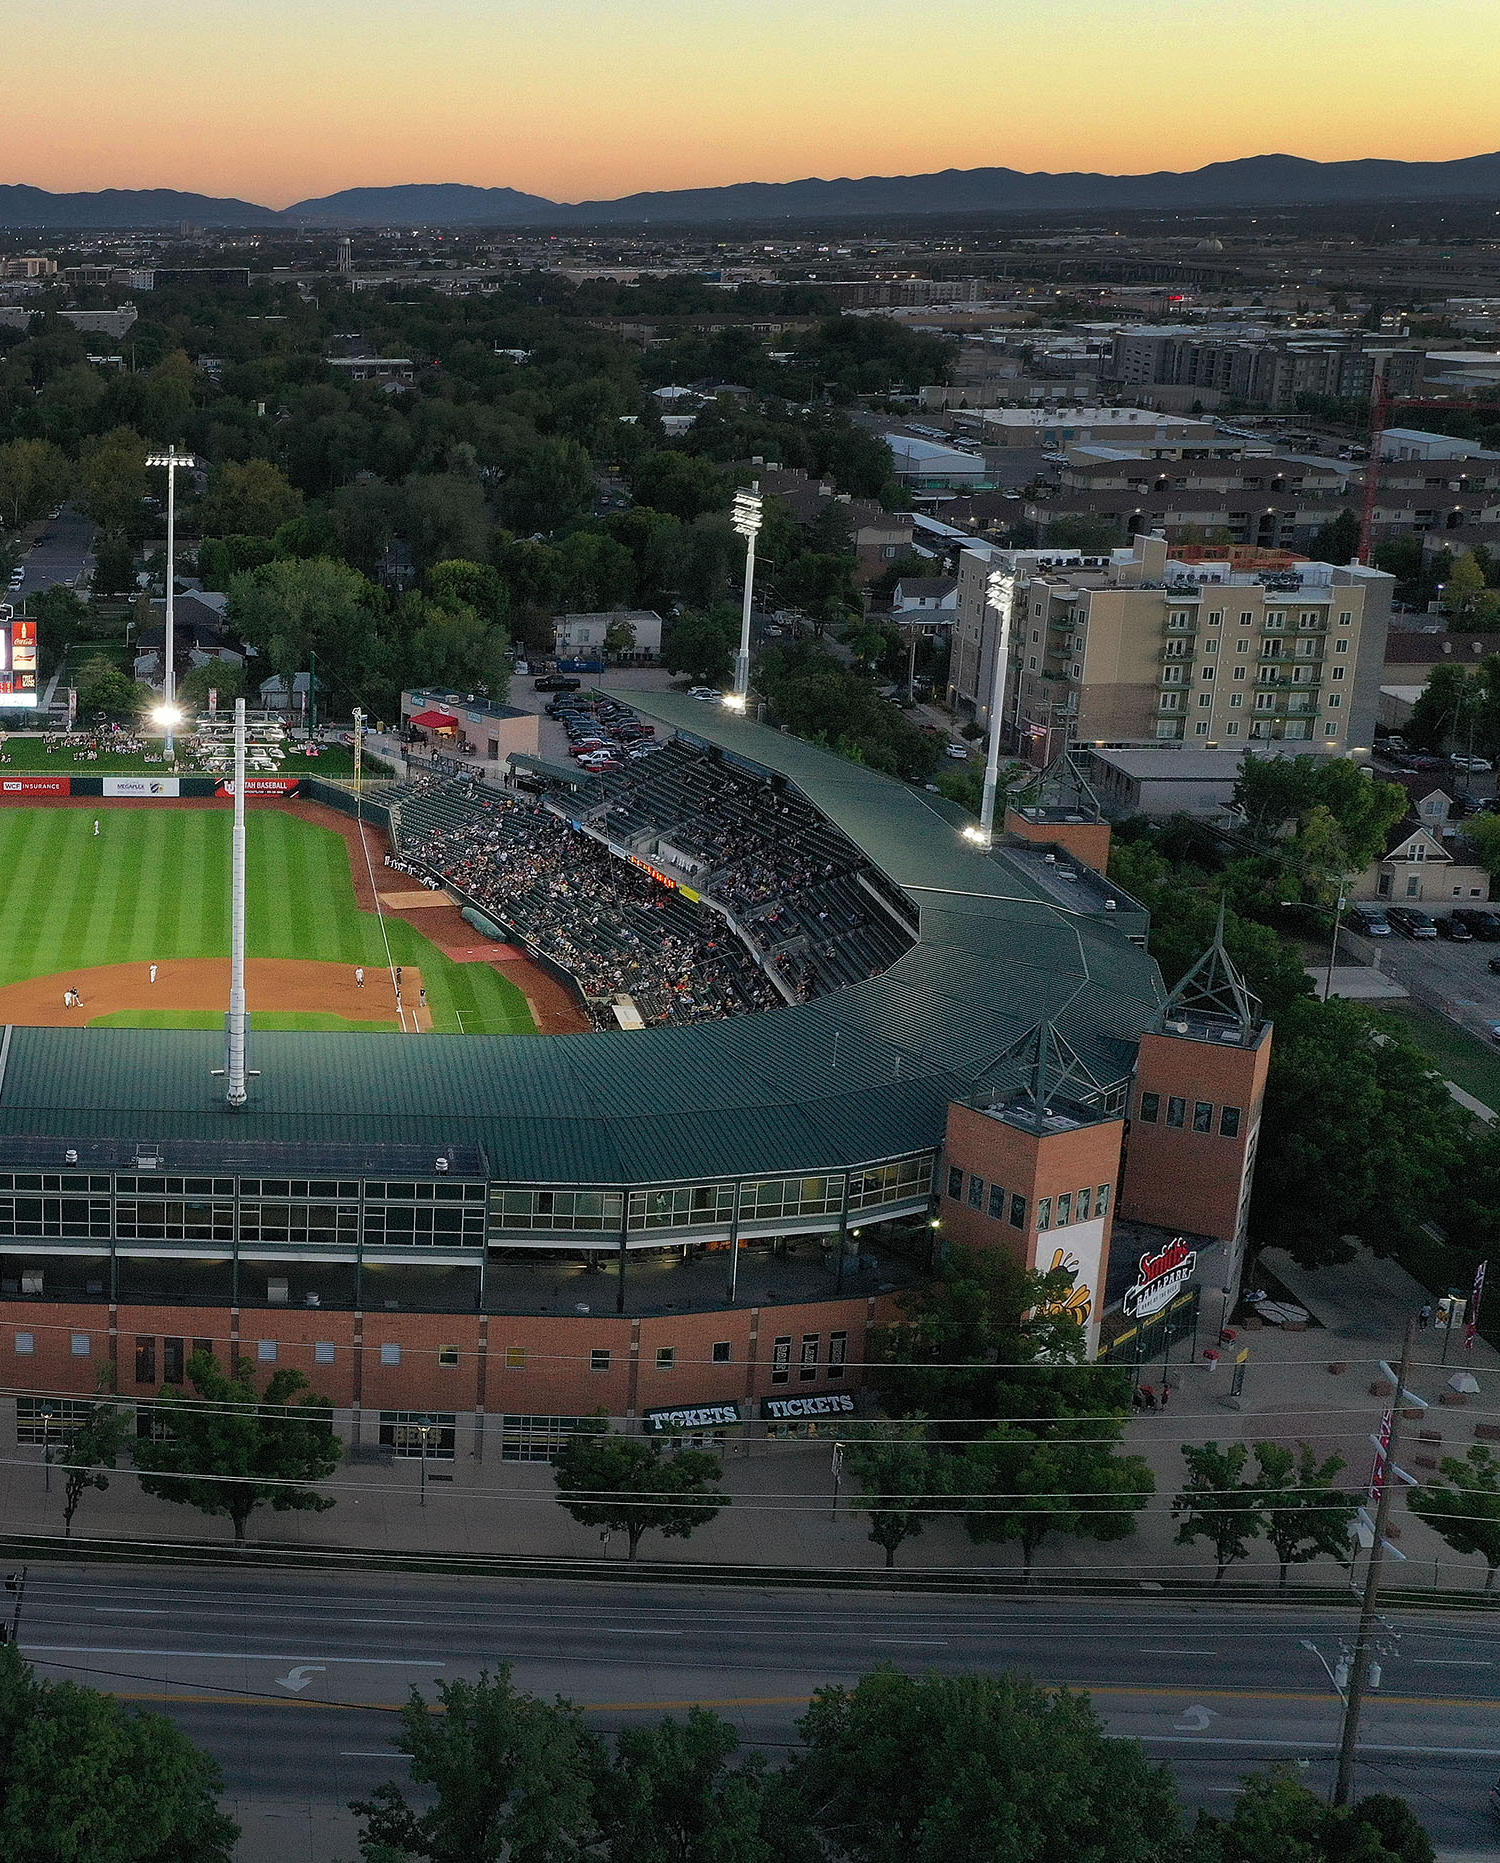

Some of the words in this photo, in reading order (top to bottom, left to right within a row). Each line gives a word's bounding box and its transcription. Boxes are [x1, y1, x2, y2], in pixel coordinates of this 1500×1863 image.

[256, 782, 287, 790] BASEBALL
[1137, 1267, 1189, 1305] BALLPARK
[768, 1395, 854, 1418] TICKETS
